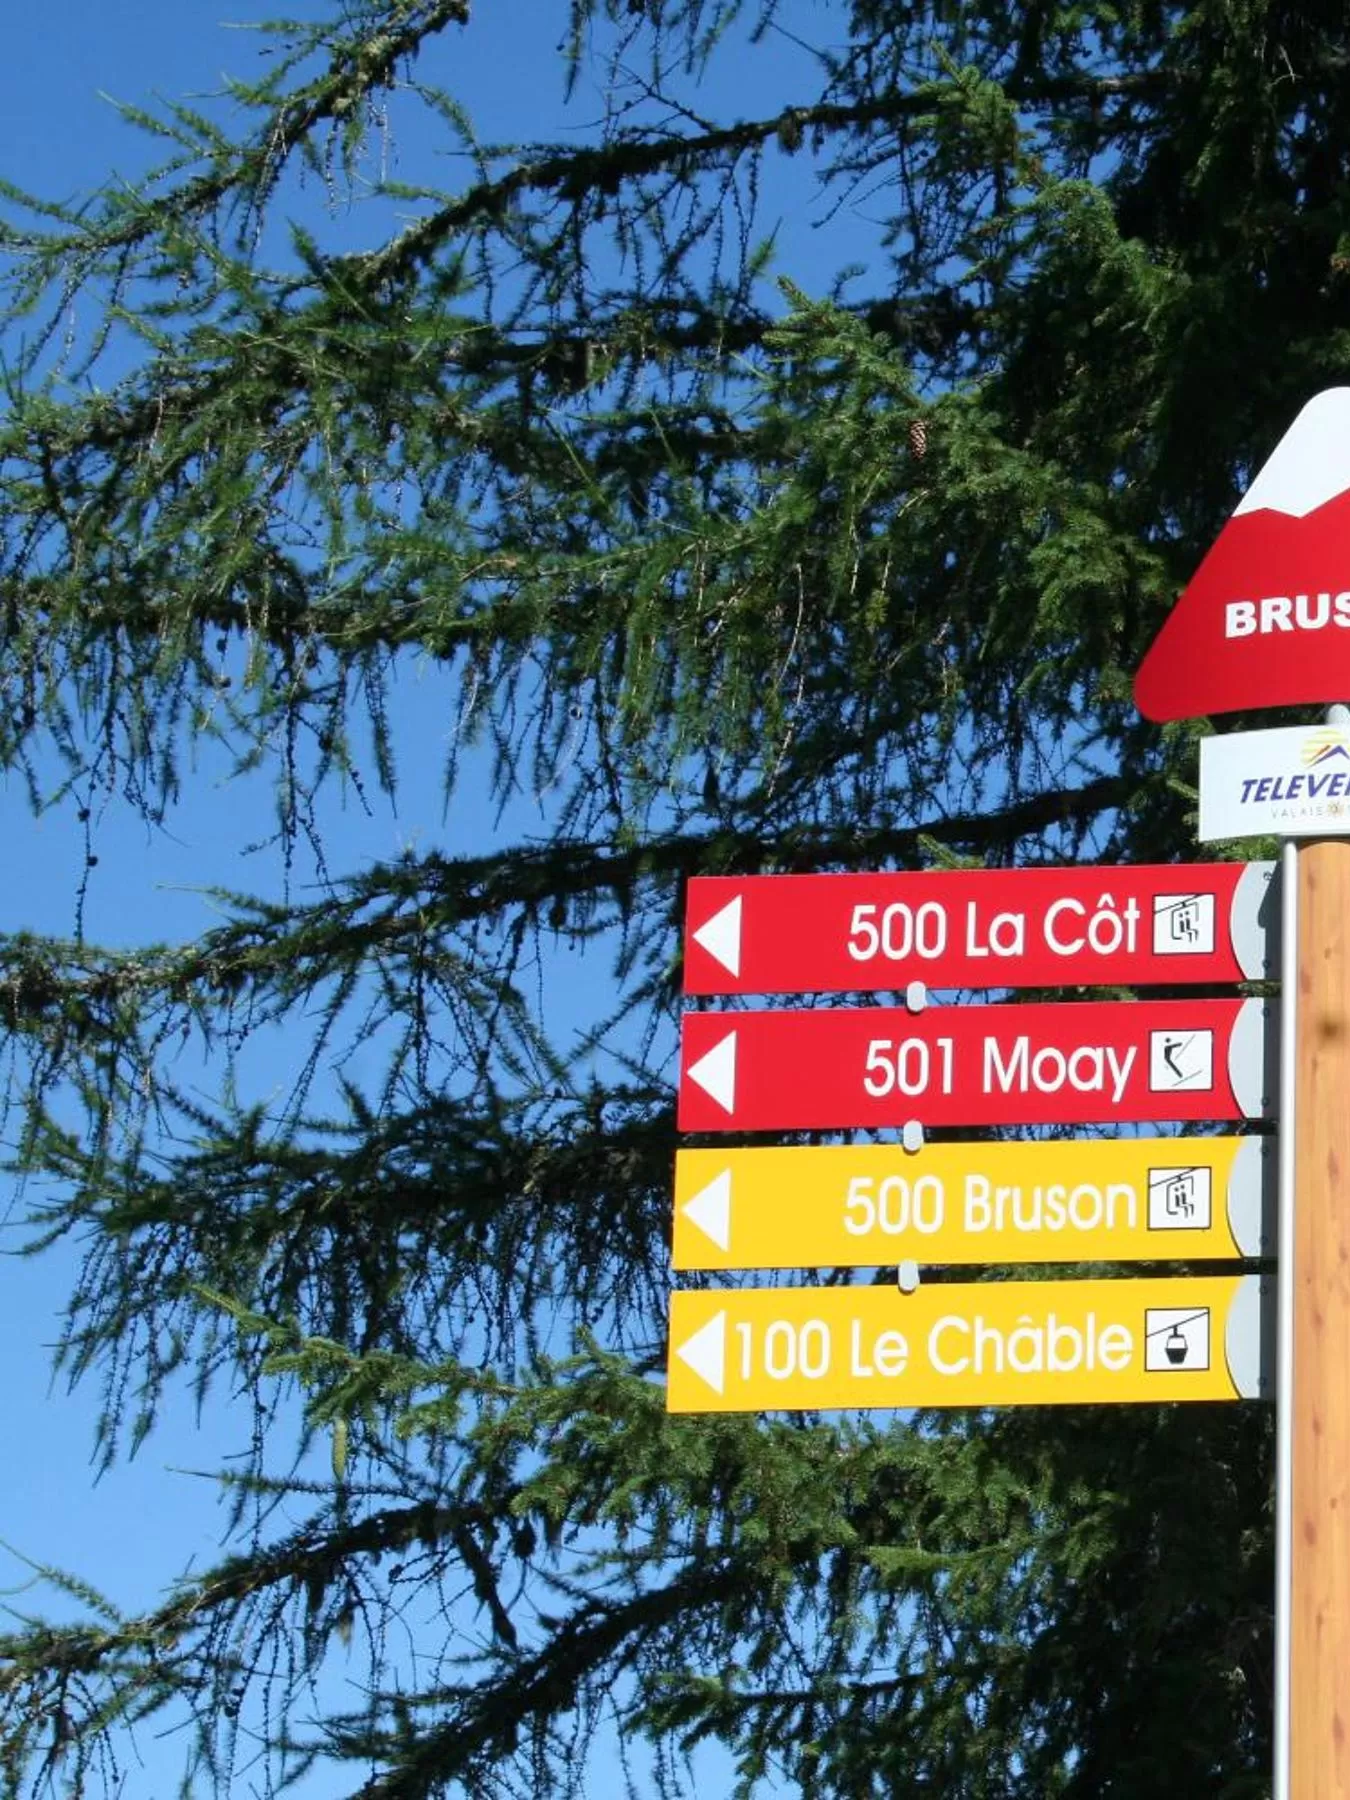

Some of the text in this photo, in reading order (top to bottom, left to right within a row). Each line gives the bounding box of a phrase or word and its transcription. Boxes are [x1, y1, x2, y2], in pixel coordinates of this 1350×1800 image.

[847, 893, 1140, 960] 500 La Côt
[864, 1035, 1138, 1103] 501 Moay
[844, 1174, 1137, 1235] 500 Bruson
[735, 1312, 1134, 1380] 100 Le Châble
